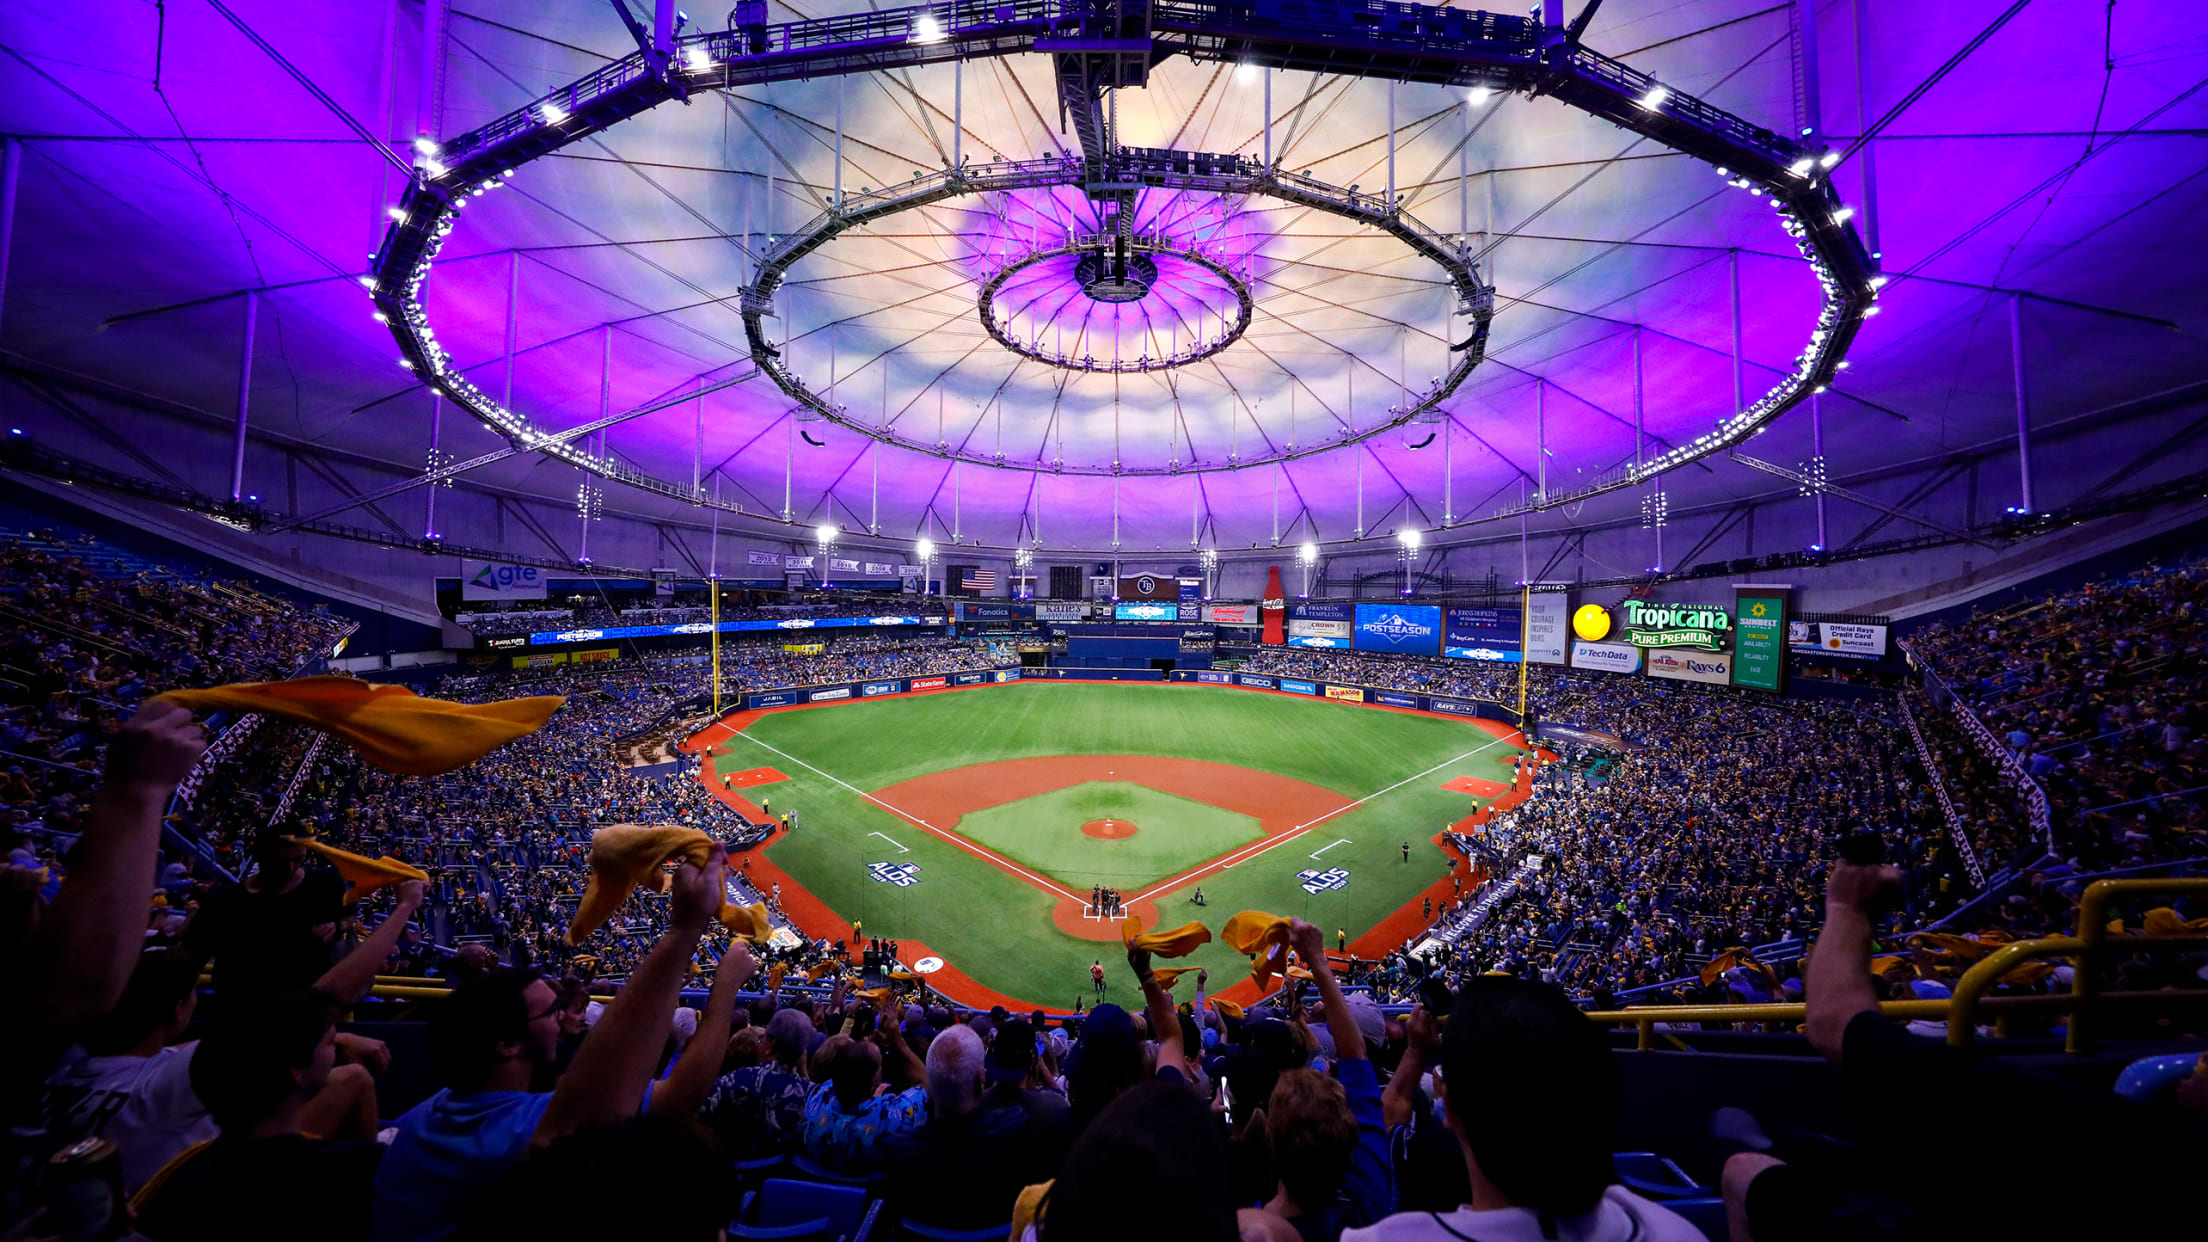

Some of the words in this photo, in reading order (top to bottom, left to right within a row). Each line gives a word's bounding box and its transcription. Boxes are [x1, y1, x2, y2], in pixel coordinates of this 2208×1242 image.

[497, 565, 537, 585] gte
[978, 608, 1009, 616] Fanatics
[1624, 600, 1729, 630] Tropicana
[1740, 618, 1778, 627] SUNBELT
[1363, 624, 1432, 635] POSTSEASON
[1856, 626, 1875, 634] Rays
[1632, 633, 1659, 644] PURE
[1660, 632, 1713, 644] PREMIUM
[1588, 650, 1607, 658] Tech
[1607, 651, 1628, 661] Data
[1715, 662, 1726, 674] 6
[1242, 676, 1271, 687] GEICO
[1436, 702, 1454, 711] RAYS
[867, 862, 920, 887] ALDS
[1301, 867, 1350, 895] ALDS
[1440, 913, 1479, 942] WELCOME
[1472, 904, 1487, 915] TO
